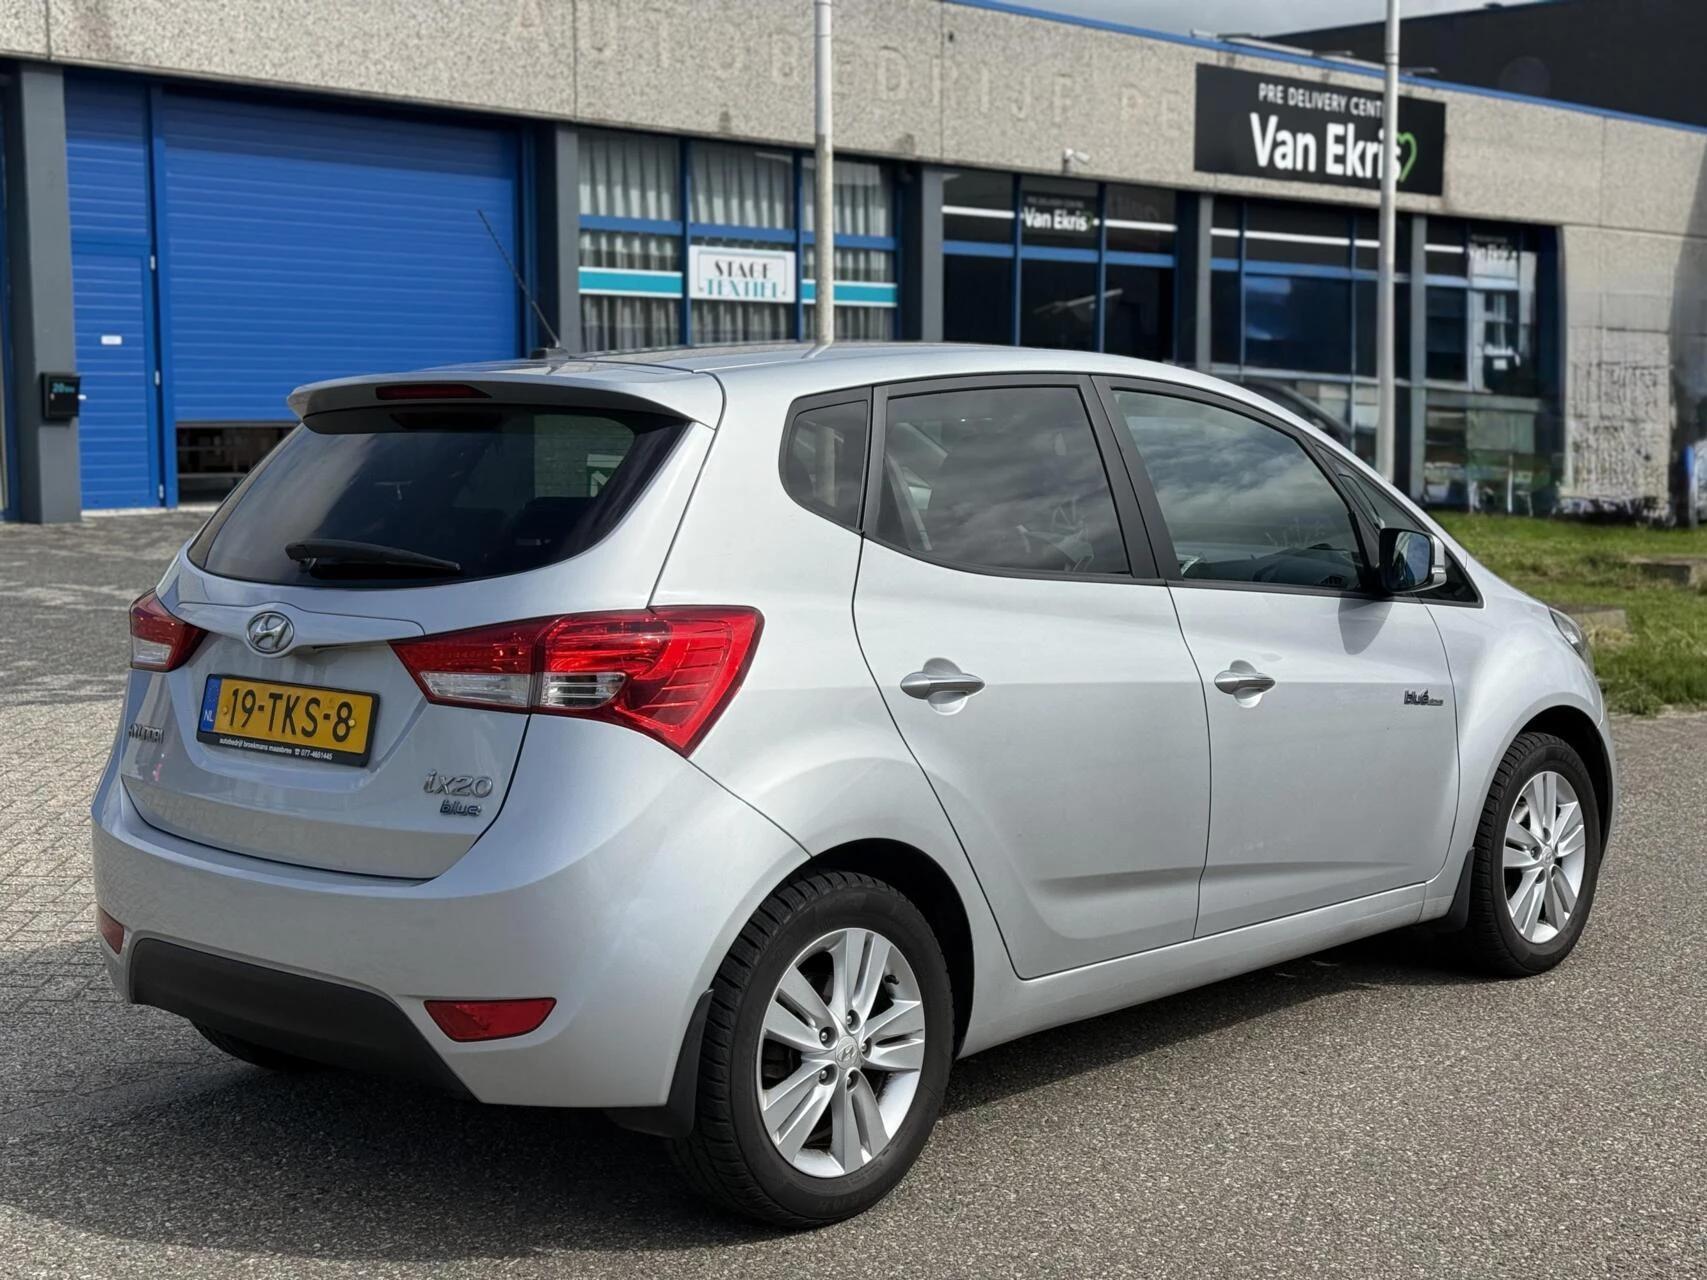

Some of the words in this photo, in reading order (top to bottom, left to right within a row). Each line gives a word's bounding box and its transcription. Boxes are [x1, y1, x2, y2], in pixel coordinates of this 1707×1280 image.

[1258, 82, 1284, 105] PRE
[1287, 87, 1349, 114] DELIVERY
[1349, 96, 1383, 119] CENT
[1249, 112, 1317, 173] Van
[1024, 206, 1052, 229] Van
[1054, 208, 1088, 232] Ekris
[203, 708, 215, 723] NL
[229, 687, 353, 744] 19-TKS-8
[423, 769, 494, 799] ix20
